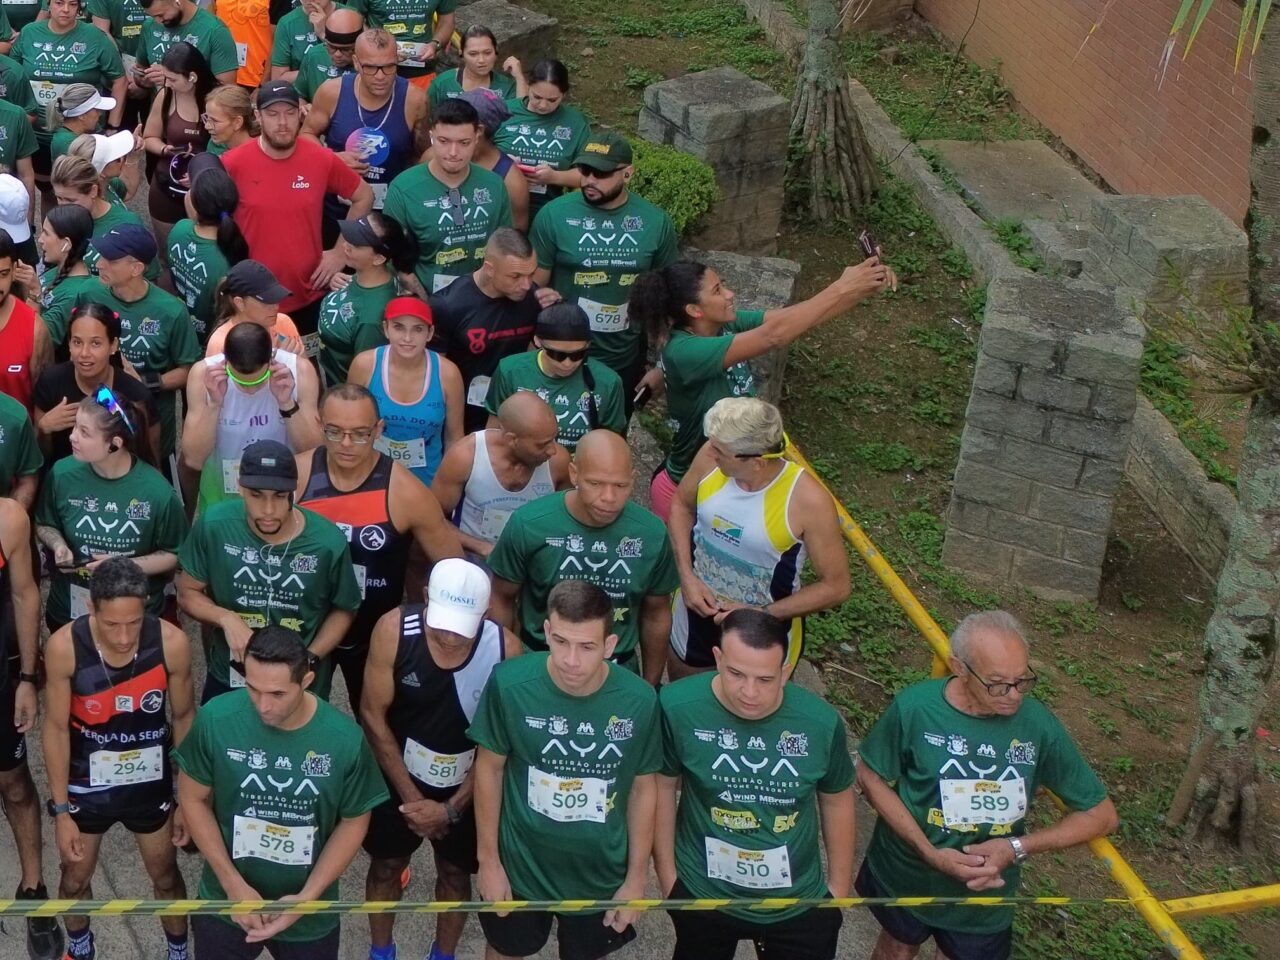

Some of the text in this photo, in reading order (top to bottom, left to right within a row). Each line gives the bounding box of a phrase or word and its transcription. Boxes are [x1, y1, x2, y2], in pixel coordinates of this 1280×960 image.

[596, 313, 620, 324] 678
[121, 733, 136, 743] DA
[114, 762, 148, 775] 294
[428, 764, 457, 778] 581
[552, 793, 588, 808] 509
[971, 796, 1009, 811] 589
[260, 835, 295, 853] 578
[736, 862, 769, 877] 510
